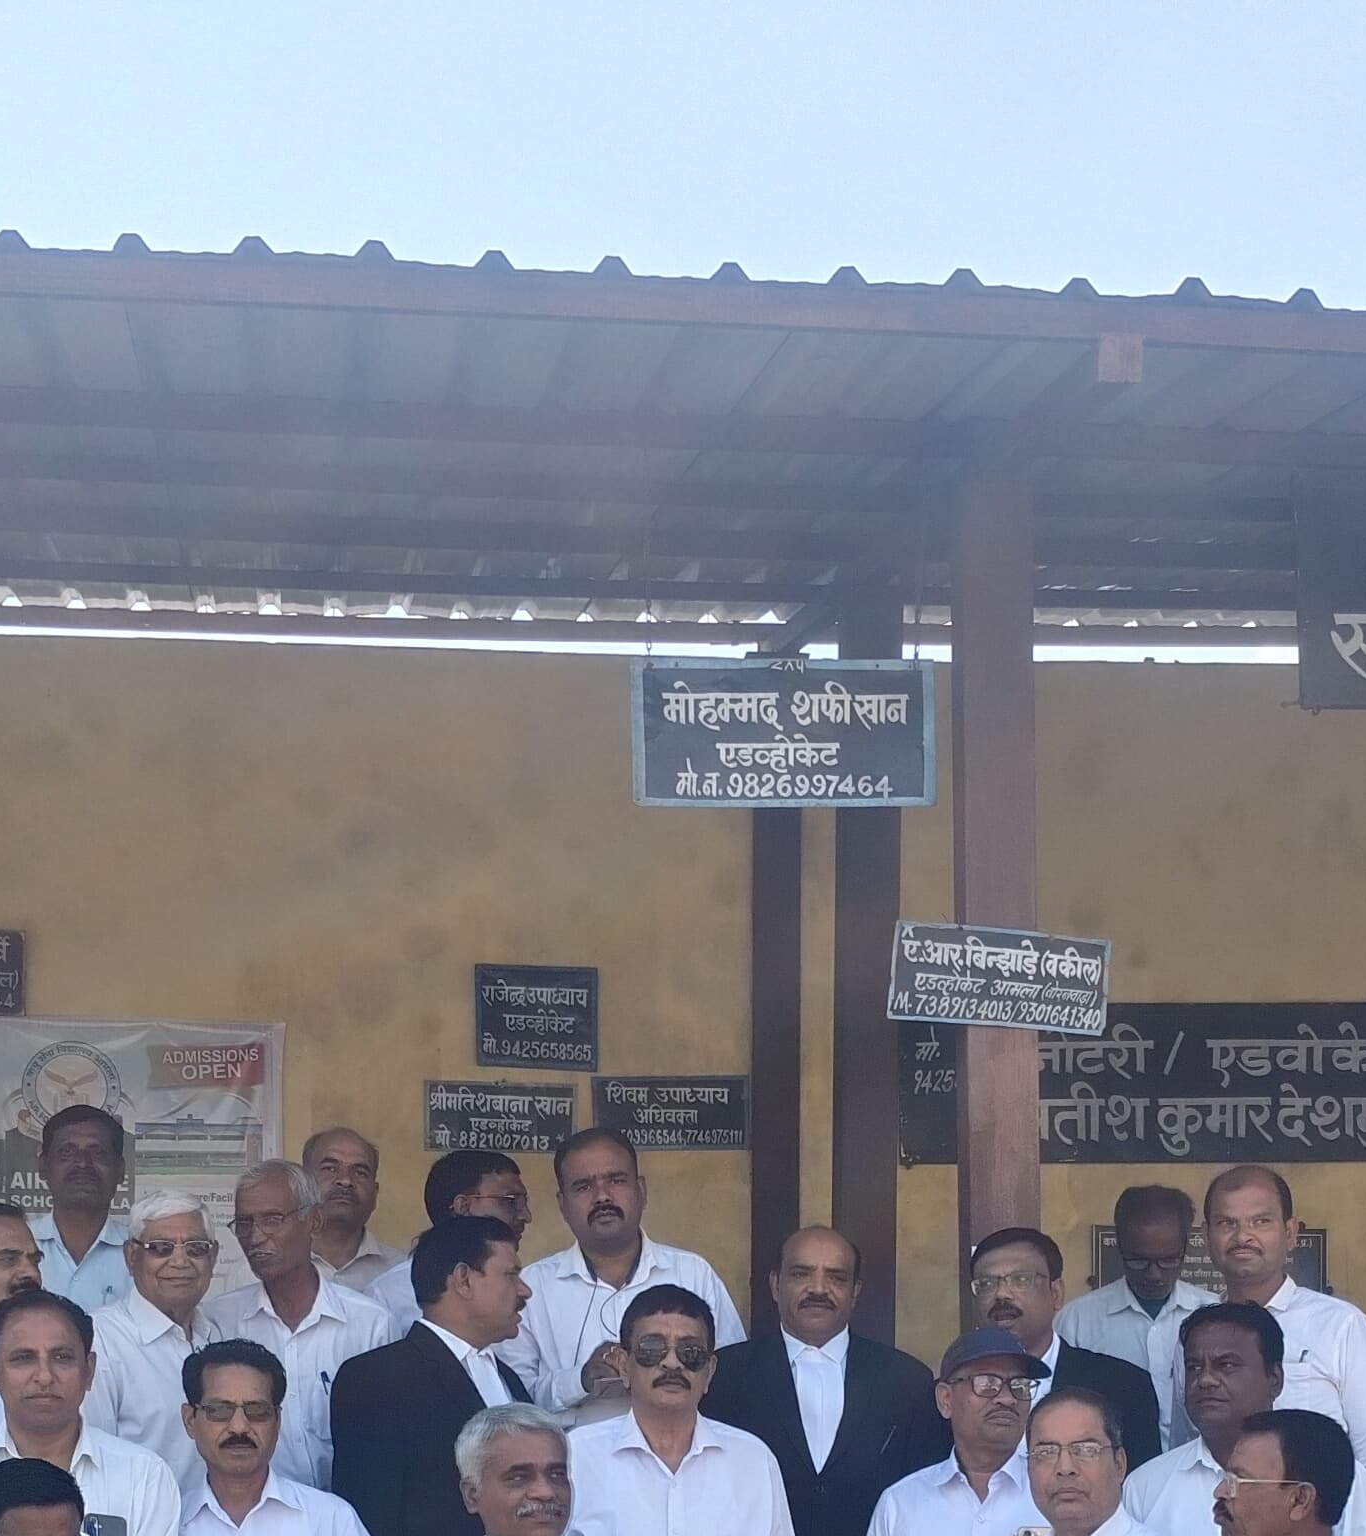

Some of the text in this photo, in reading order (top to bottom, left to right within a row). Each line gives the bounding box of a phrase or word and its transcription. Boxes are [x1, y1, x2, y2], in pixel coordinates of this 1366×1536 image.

[662, 680, 783, 731] मोहम्मद
[791, 680, 852, 727] शफी
[715, 734, 841, 773] एडव्होकेट
[726, 772, 894, 798] 9826997464
[1040, 946, 1102, 986] (वकील)
[481, 979, 589, 1008] राजेन्द्र उपाध्याय
[990, 979, 1044, 999] आमला
[162, 1048, 259, 1064] ADMISSIONS
[501, 1039, 592, 1062] 9425658565
[181, 1062, 242, 1080] OPEN
[913, 1069, 958, 1095] 9425
[535, 1096, 572, 1121] खान
[654, 1087, 730, 1105] उपाध्याय
[632, 1104, 699, 1126] अधिवक्ता
[1157, 1096, 1273, 1157] कुमार
[10, 1194, 131, 1210] SCHO LA
